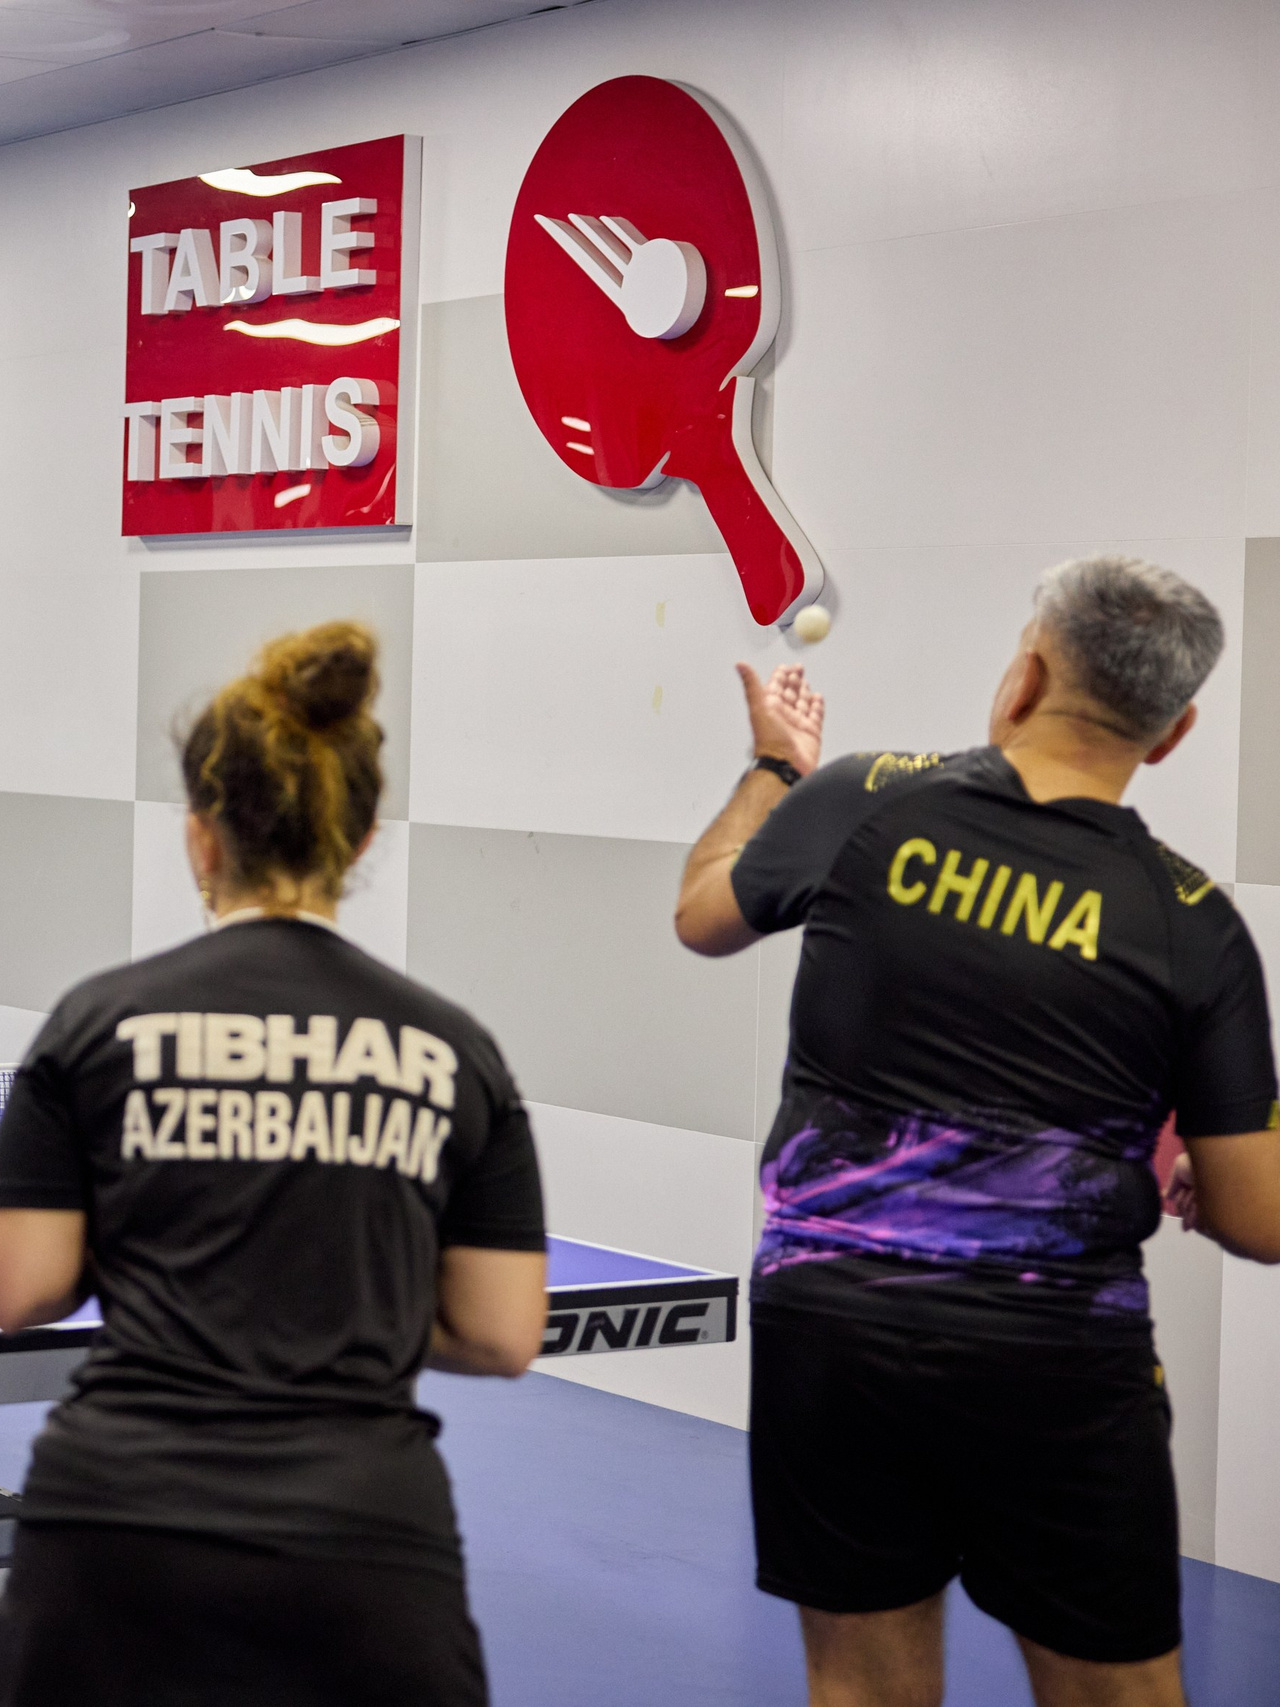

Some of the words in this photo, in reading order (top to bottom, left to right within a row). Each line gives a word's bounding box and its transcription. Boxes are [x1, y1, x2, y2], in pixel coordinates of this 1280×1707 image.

[129, 197, 378, 316] TABLE
[123, 376, 380, 482] TENNIS
[886, 837, 1103, 962] CHINA
[115, 1012, 459, 1111] TIBHAR
[121, 1087, 453, 1185] AZERBAIJAN
